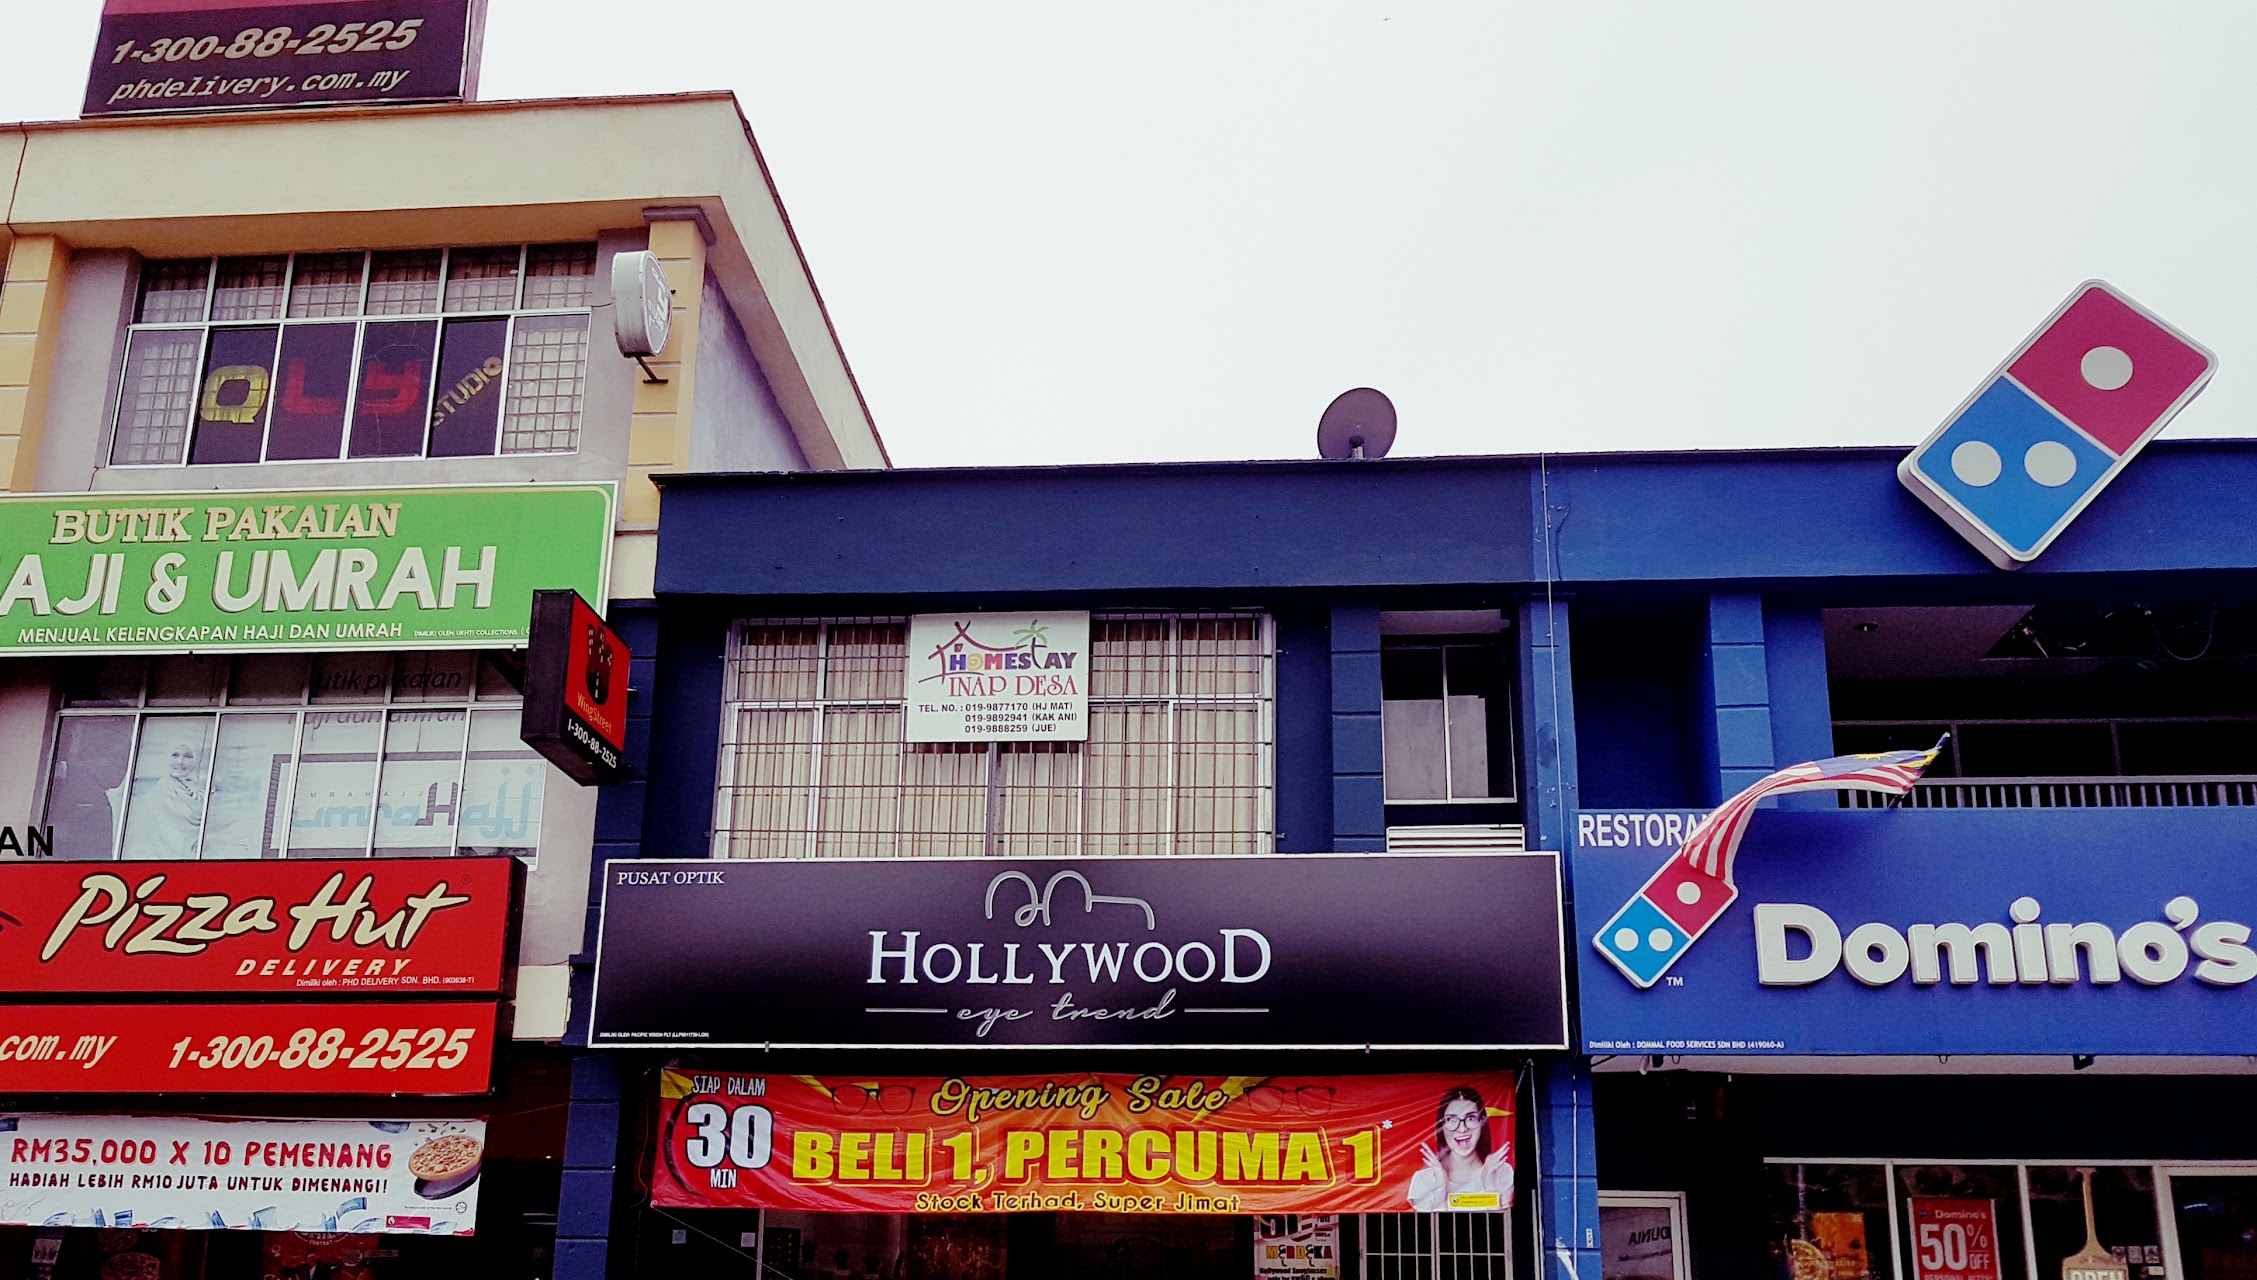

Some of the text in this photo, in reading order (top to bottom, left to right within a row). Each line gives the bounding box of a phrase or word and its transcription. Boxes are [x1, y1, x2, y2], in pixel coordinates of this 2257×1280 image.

[111, 19, 424, 65] 1-300-88-2525
[106, 67, 411, 105] phdelivery.com.my
[432, 356, 503, 427] STUDIO
[49, 503, 403, 544] BUTIK PAKAIAN
[145, 551, 188, 615] &
[212, 545, 497, 614] UMRAH
[18, 623, 403, 643] MENJUAL KELENGKAPAN HAJI DAN UMRAH
[949, 643, 1078, 671] HOMESTAY
[314, 667, 362, 691] utik
[948, 674, 1079, 697] INAP DESA
[577, 691, 613, 735] WingStreet
[918, 704, 939, 713] TEL.
[941, 704, 958, 712] NO.
[965, 702, 1029, 712] 019-9877170
[1031, 702, 1048, 711] (HJ
[1050, 702, 1073, 711] MAT)
[965, 712, 1078, 723] 019-9892941 (KAK ANI)
[567, 718, 618, 769] 1-300-88-2525
[964, 724, 1057, 733] 019-9888259 (JUE)
[1578, 813, 1711, 848] RESTORA
[616, 871, 725, 885] PUSAT OPTIK
[39, 871, 470, 963] Pizza Hut
[866, 927, 1272, 985] HOLLYWOOD
[1753, 896, 2257, 987] Domino's
[235, 958, 412, 977] DELIVERY
[342, 977, 359, 986] PHD
[360, 977, 399, 986] DELIVERY
[401, 976, 420, 984] SDN.
[422, 976, 442, 984] BHD.
[1666, 976, 1684, 987] TM
[957, 987, 1178, 1038] eye trend
[168, 1028, 475, 1071] 1-300-88-2525
[1666, 1041, 1685, 1049] FOOD
[1686, 1041, 1716, 1049] SERVICES
[1717, 1041, 1731, 1049] SDN
[1732, 1041, 1746, 1049] BHD
[691, 1075, 767, 1096] SIAP DALAM
[930, 1074, 1231, 1123] Opening Sale
[685, 1102, 774, 1170] 30
[10, 1138, 158, 1168] RM35,000
[203, 1140, 232, 1166] 10
[243, 1140, 393, 1169] PEMENANG
[790, 1130, 930, 1182] BELI
[942, 1130, 990, 1186] 1,
[1005, 1129, 1324, 1182] PERCUMA
[9, 1173, 389, 1194] HADIAH LEBIH RM10 JUTA UNTUK DIMENANGI!
[708, 1167, 738, 1190] MIN
[915, 1190, 1242, 1214] Stock Terhad, Super Jimat
[1920, 1223, 1988, 1271] 50%
[1968, 1253, 1990, 1271] OFF
